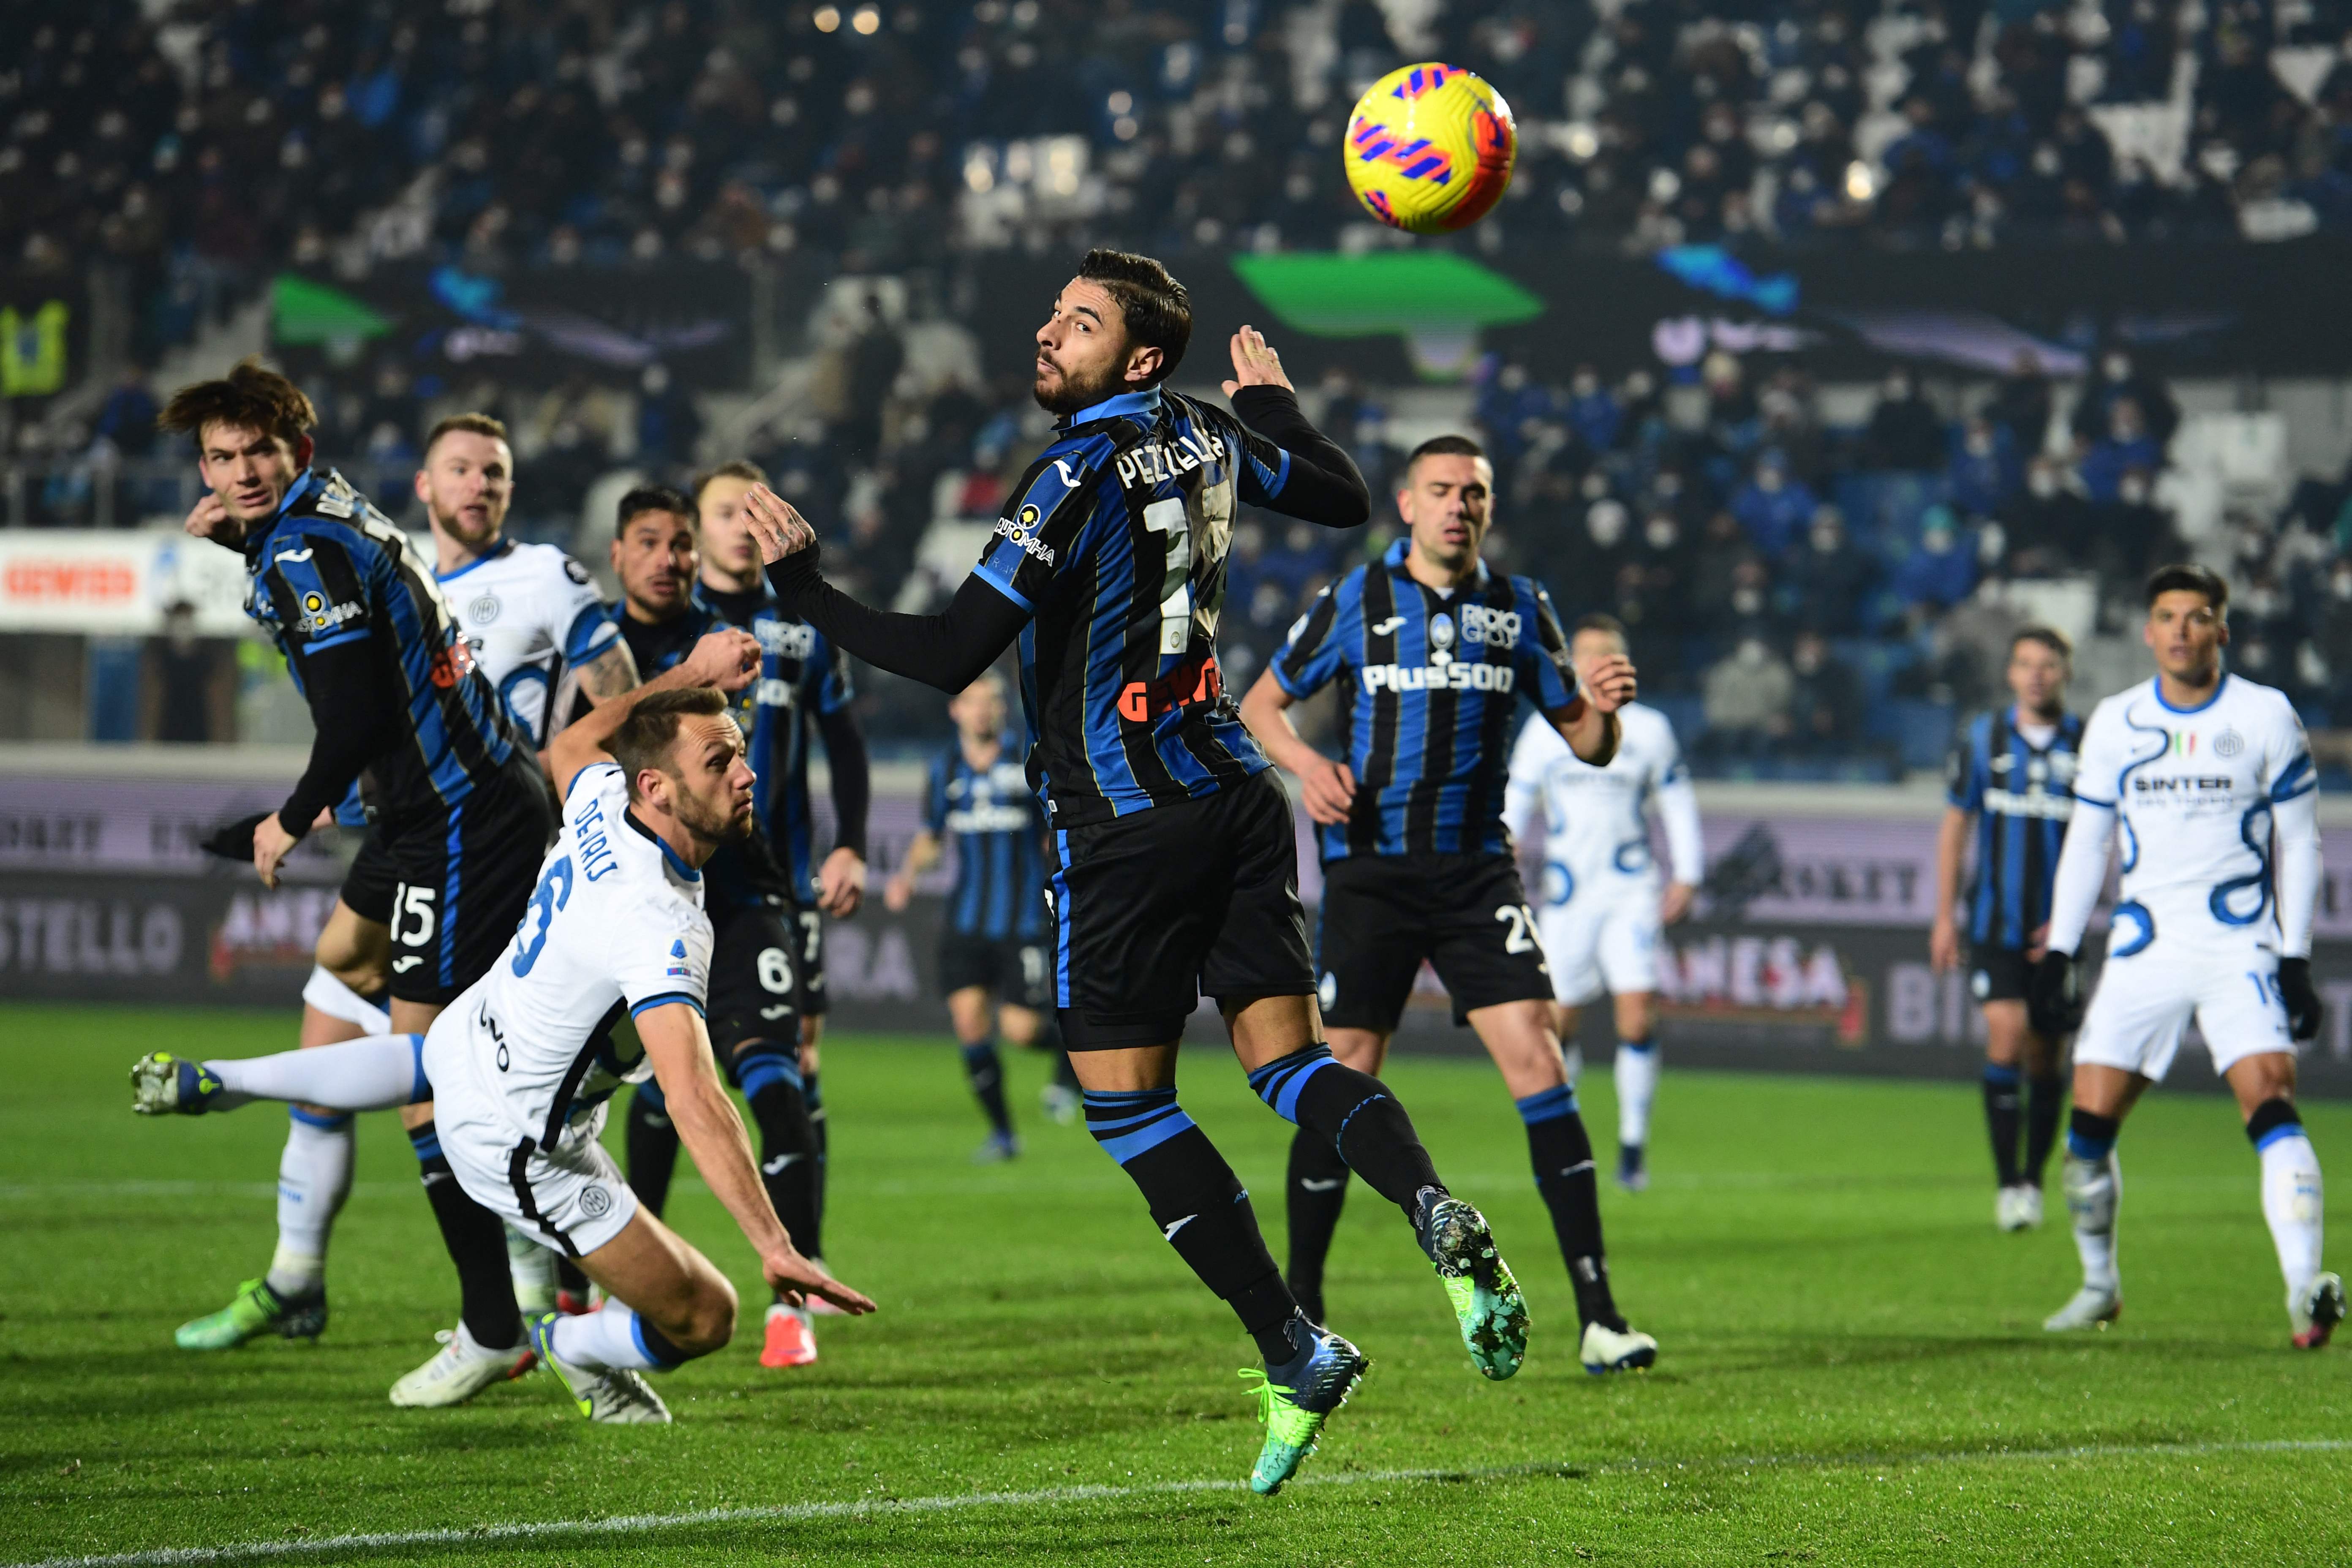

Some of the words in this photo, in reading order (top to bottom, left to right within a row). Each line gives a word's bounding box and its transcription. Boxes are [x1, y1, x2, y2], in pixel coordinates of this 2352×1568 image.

[994, 517, 1054, 567] AUTOMHA
[1361, 662, 1515, 695] Plus500
[390, 881, 436, 947] 15
[757, 947, 794, 995] 6
